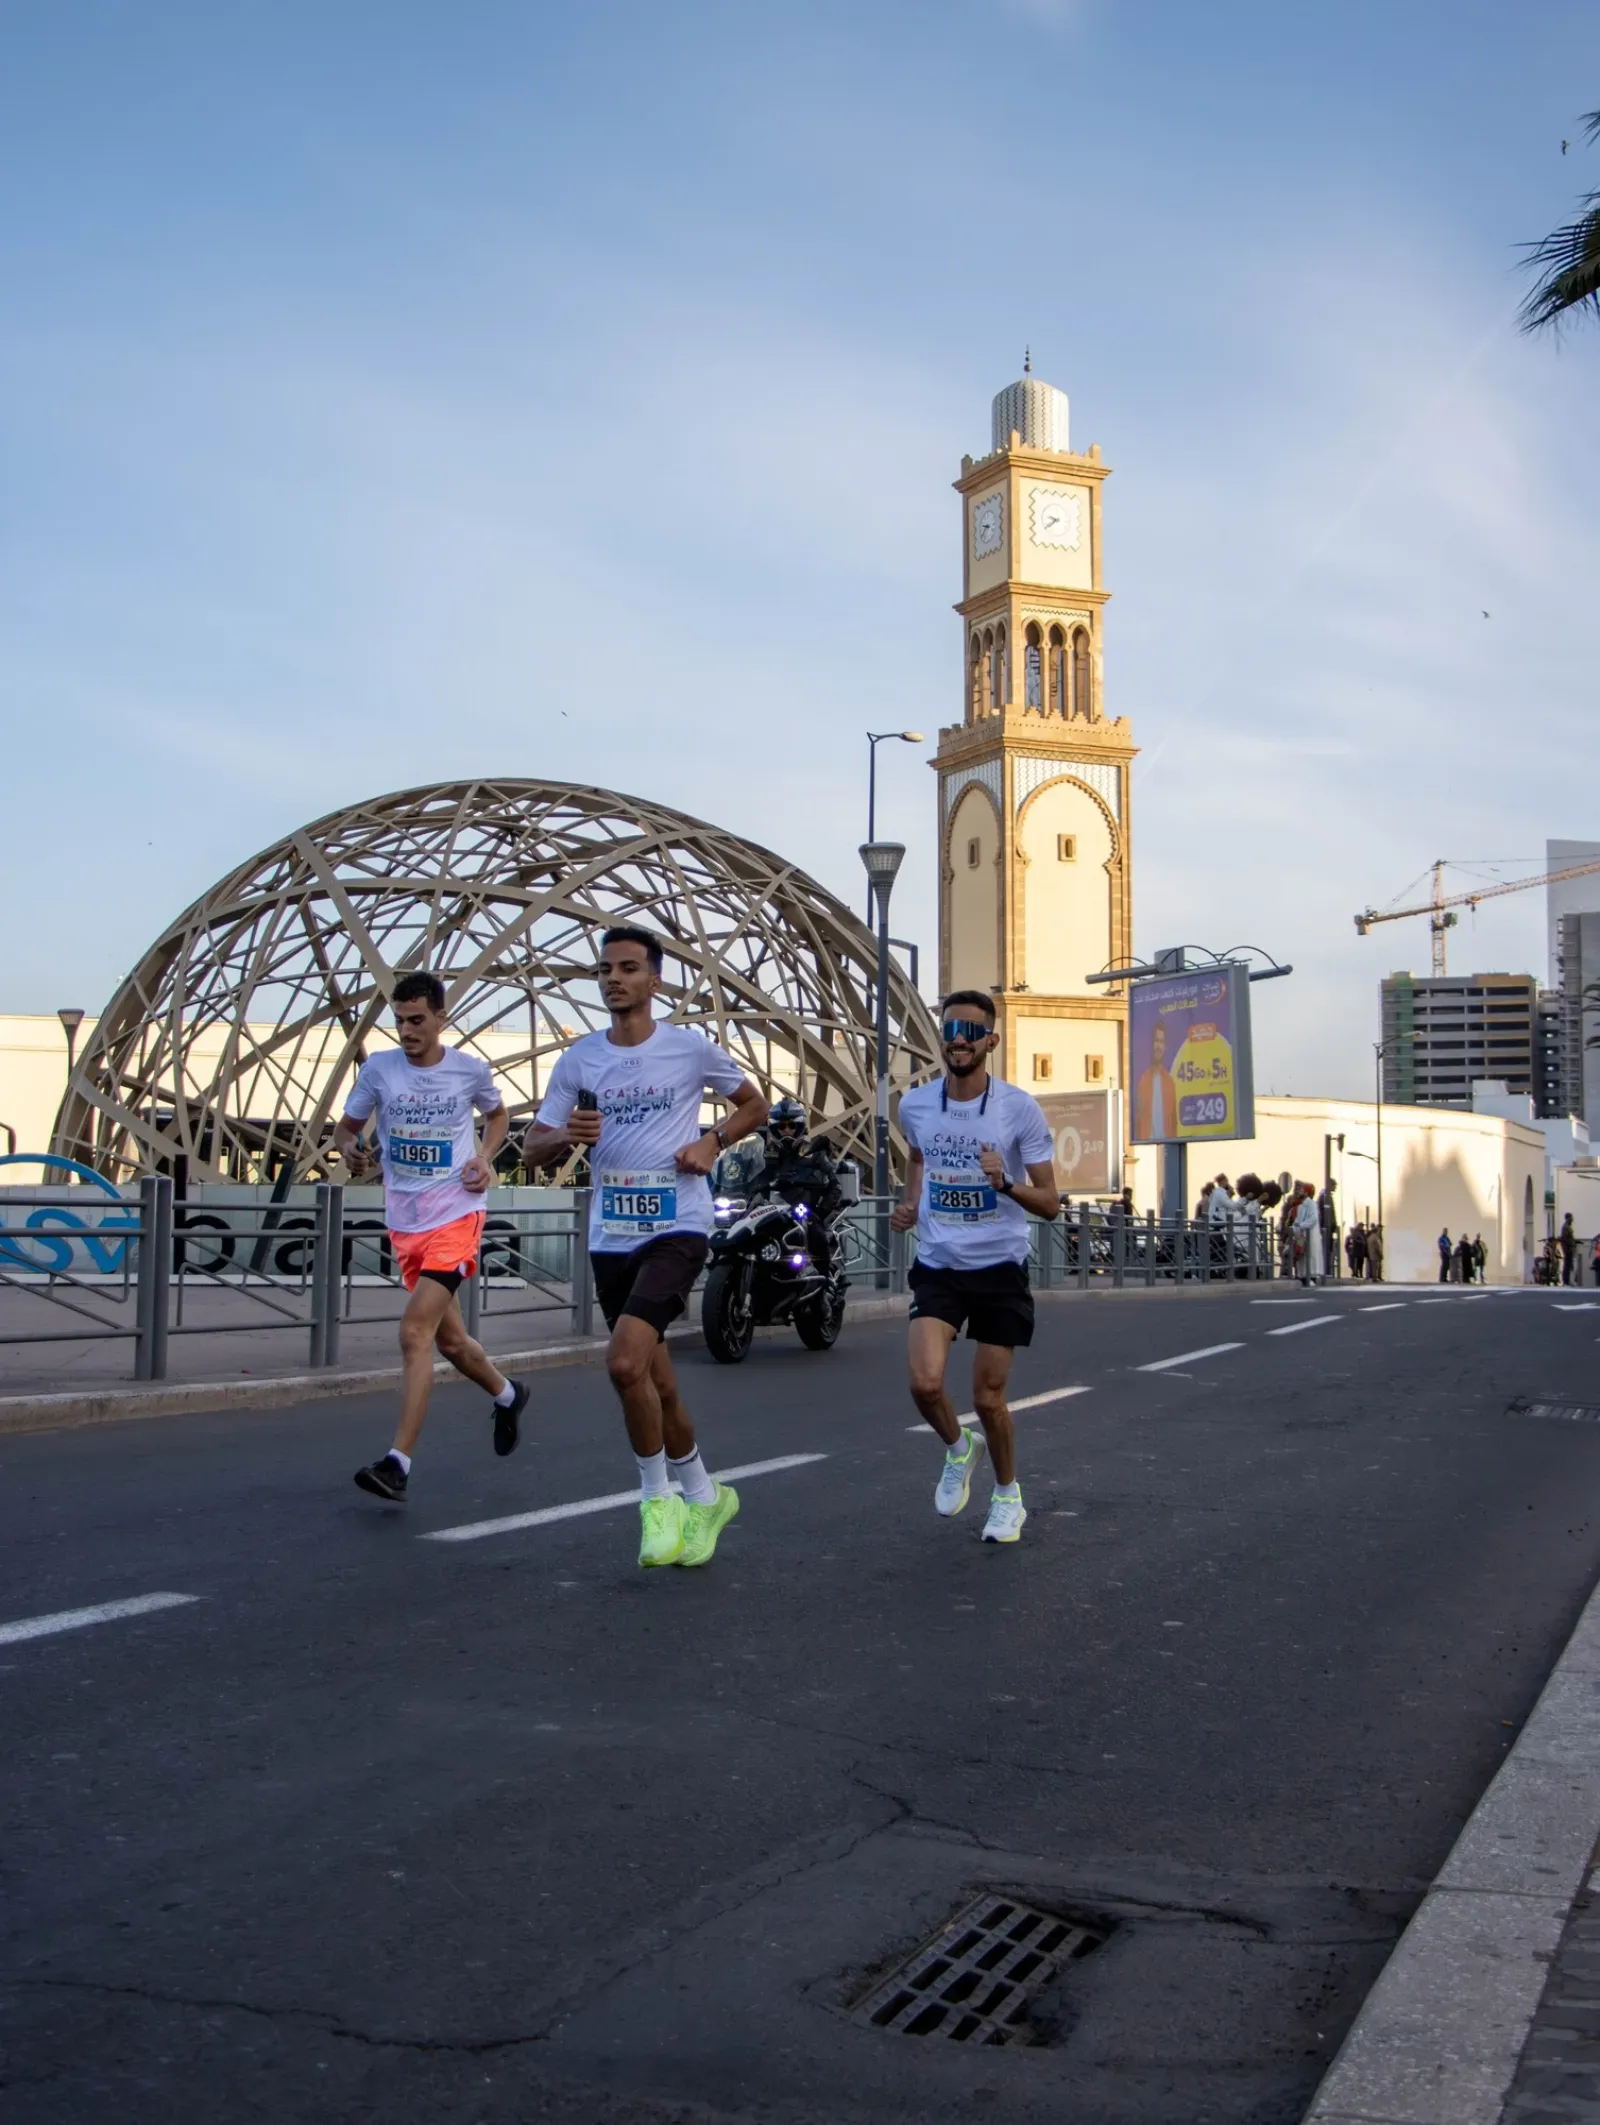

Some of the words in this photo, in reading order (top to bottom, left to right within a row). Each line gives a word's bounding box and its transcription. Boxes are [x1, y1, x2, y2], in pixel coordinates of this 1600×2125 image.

[397, 1093, 440, 1103] CASA
[604, 1086, 654, 1099] CASA
[1196, 1097, 1225, 1121] 249
[616, 1114, 645, 1125] RACE
[934, 1133, 977, 1146] CASA
[401, 1145, 437, 1162] 1961
[924, 1148, 981, 1160] DOWNTOW
[941, 1159, 968, 1168] RACE
[615, 1195, 660, 1214] 1165
[940, 1190, 981, 1208] 2851
